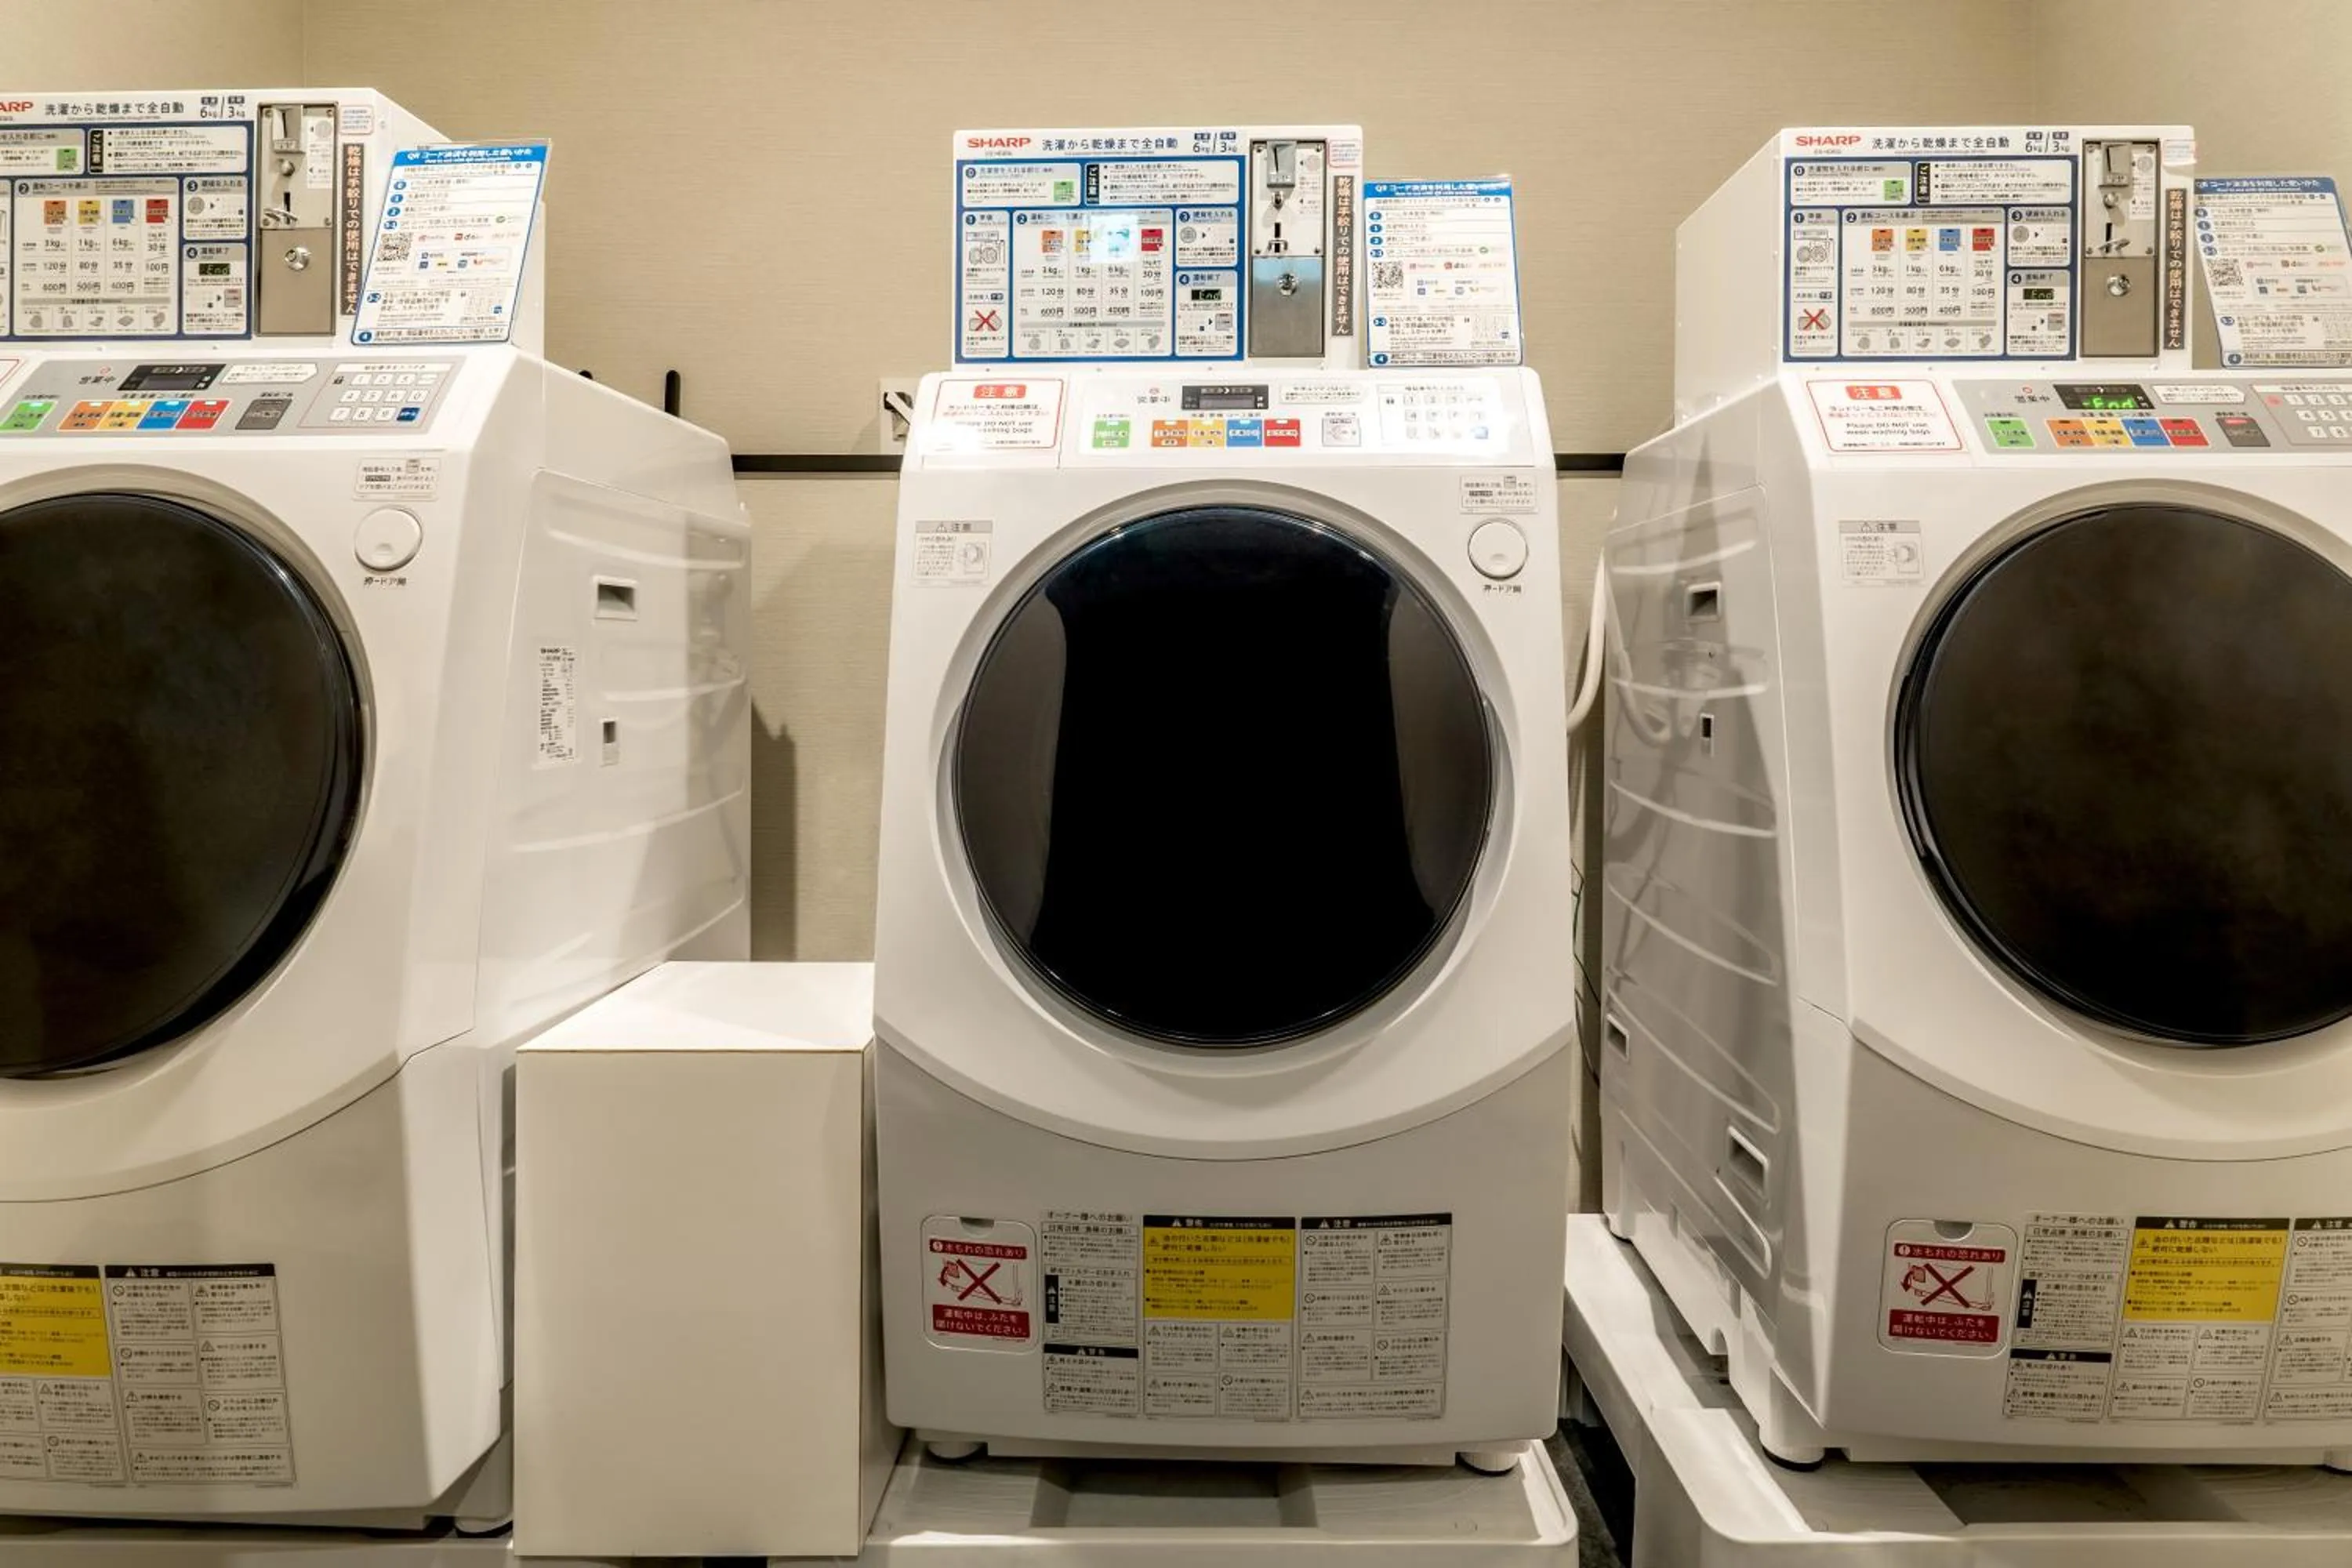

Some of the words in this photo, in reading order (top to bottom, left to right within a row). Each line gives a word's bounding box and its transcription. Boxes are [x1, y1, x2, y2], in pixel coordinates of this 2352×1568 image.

[45, 101, 184, 116] 洗濯から乾燥まで全自動
[967, 137, 1032, 148] SHARP
[1041, 139, 1180, 151] 洗濯から乾燥まで全自動
[1795, 135, 1861, 147] SHARP
[1871, 137, 2010, 150] 洗濯から乾燥まで全自動
[1336, 176, 1351, 334] 乾燥は手絞りでの使用はできません
[981, 385, 1024, 398] 注意
[1853, 387, 1896, 399] 注意
[2034, 1214, 2125, 1225] オーナー様へのお願い
[1912, 1247, 2002, 1261] 水もれの恐れあり
[1903, 1314, 1987, 1327] 運転中は、ふたを
[1892, 1324, 1994, 1341] 開けないでください。
